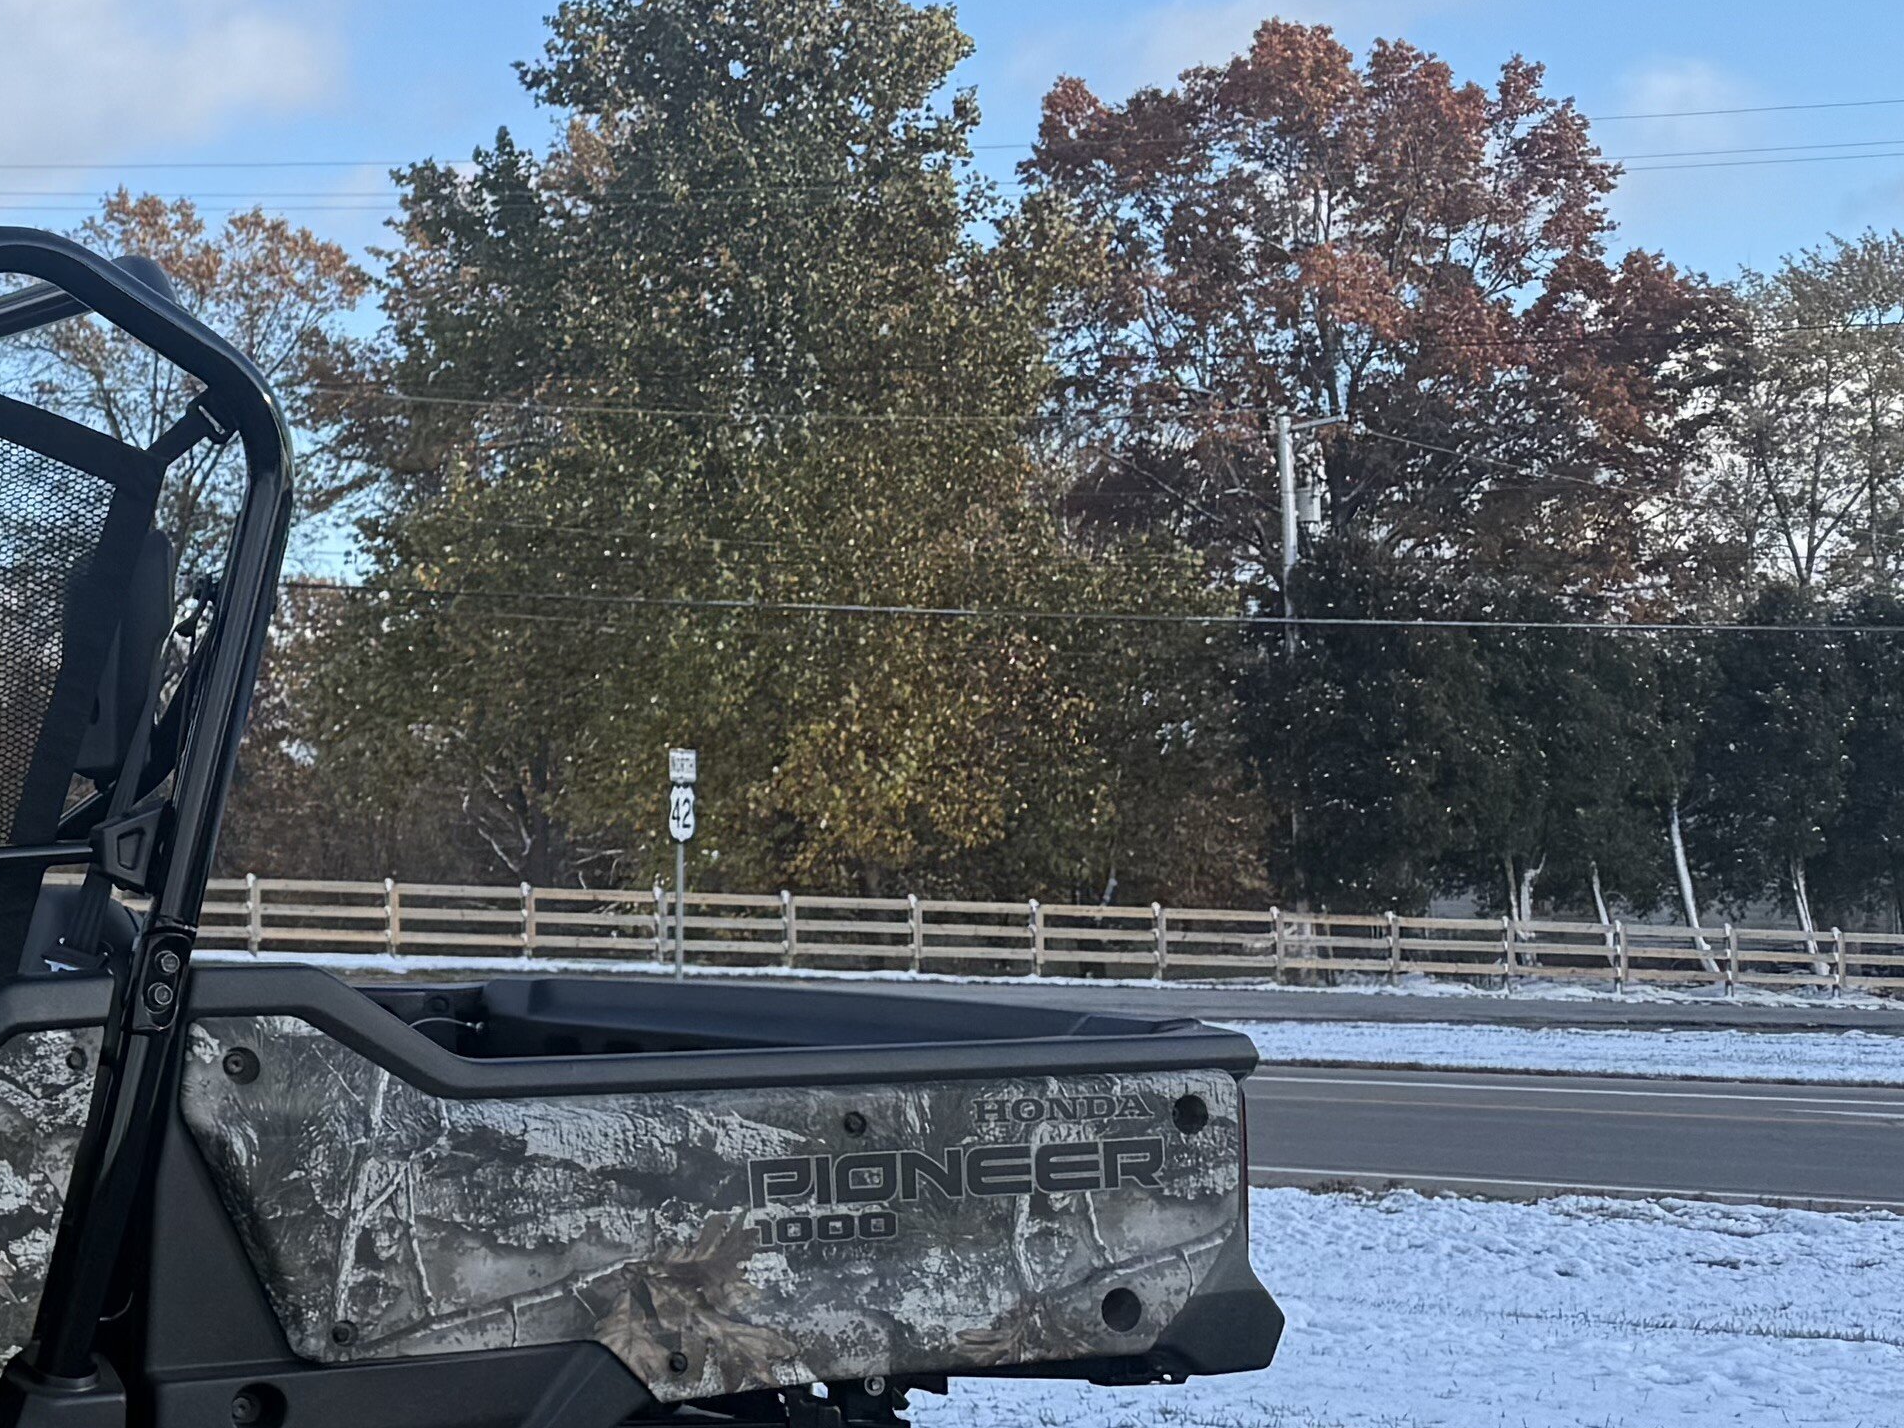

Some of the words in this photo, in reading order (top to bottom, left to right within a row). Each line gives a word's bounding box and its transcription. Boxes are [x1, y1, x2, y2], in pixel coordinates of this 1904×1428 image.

[671, 797, 691, 829] 42
[974, 1093, 1154, 1124] HONDA
[748, 1137, 1165, 1209] PIONEER
[753, 1210, 898, 1247] 1000
